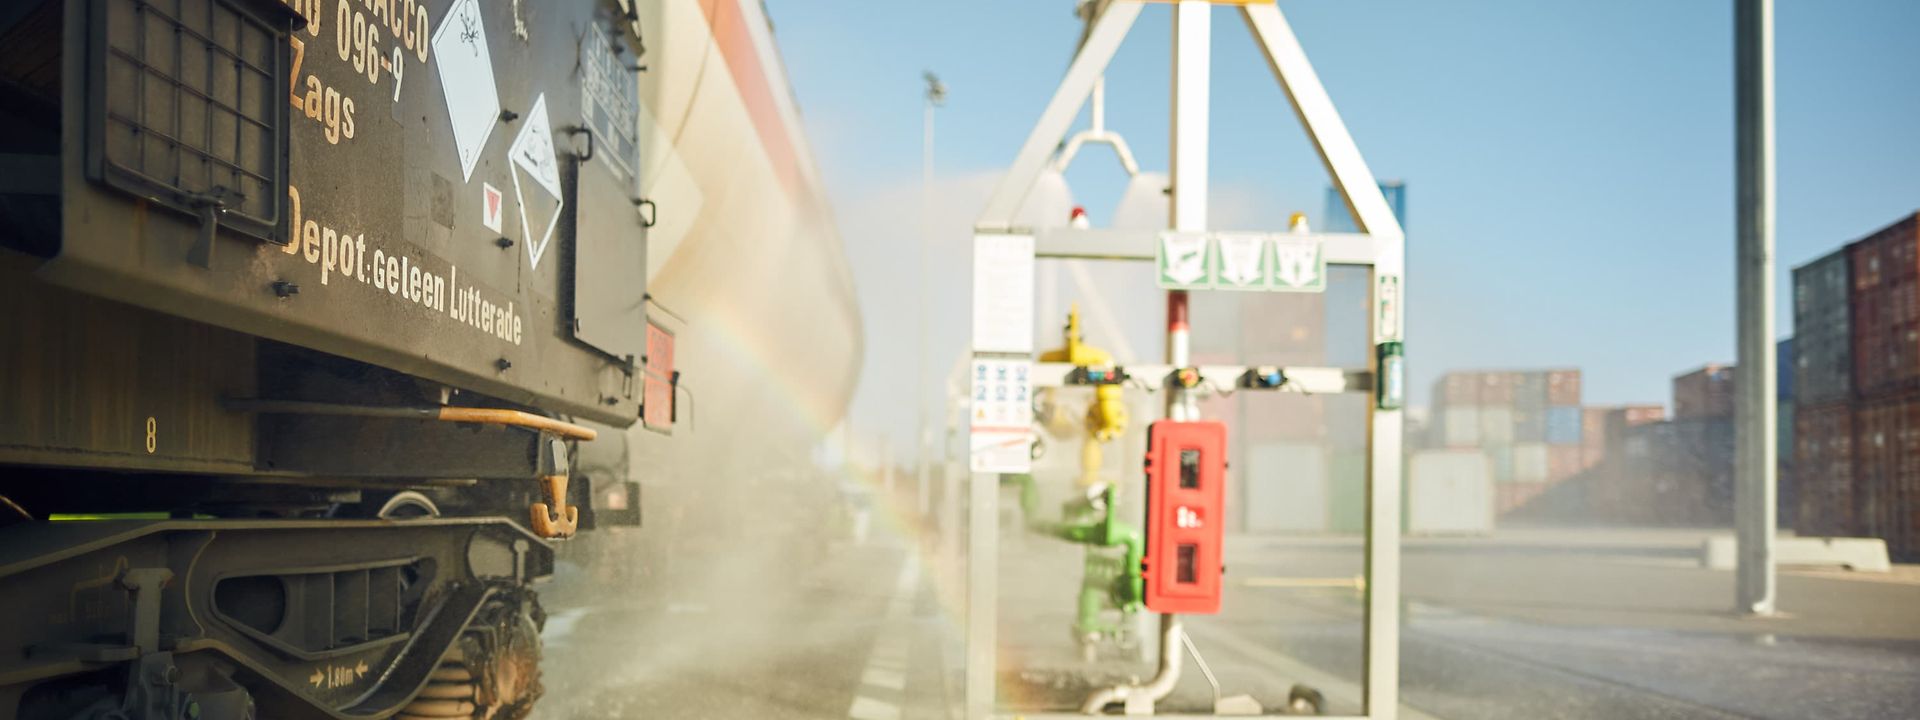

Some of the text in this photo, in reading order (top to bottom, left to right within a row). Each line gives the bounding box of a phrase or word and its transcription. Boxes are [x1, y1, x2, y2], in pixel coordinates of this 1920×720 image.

[290, 35, 355, 145] Zags
[337, 0, 403, 102] 096-9
[450, 265, 521, 345] Lutterade
[146, 416, 156, 453] 8
